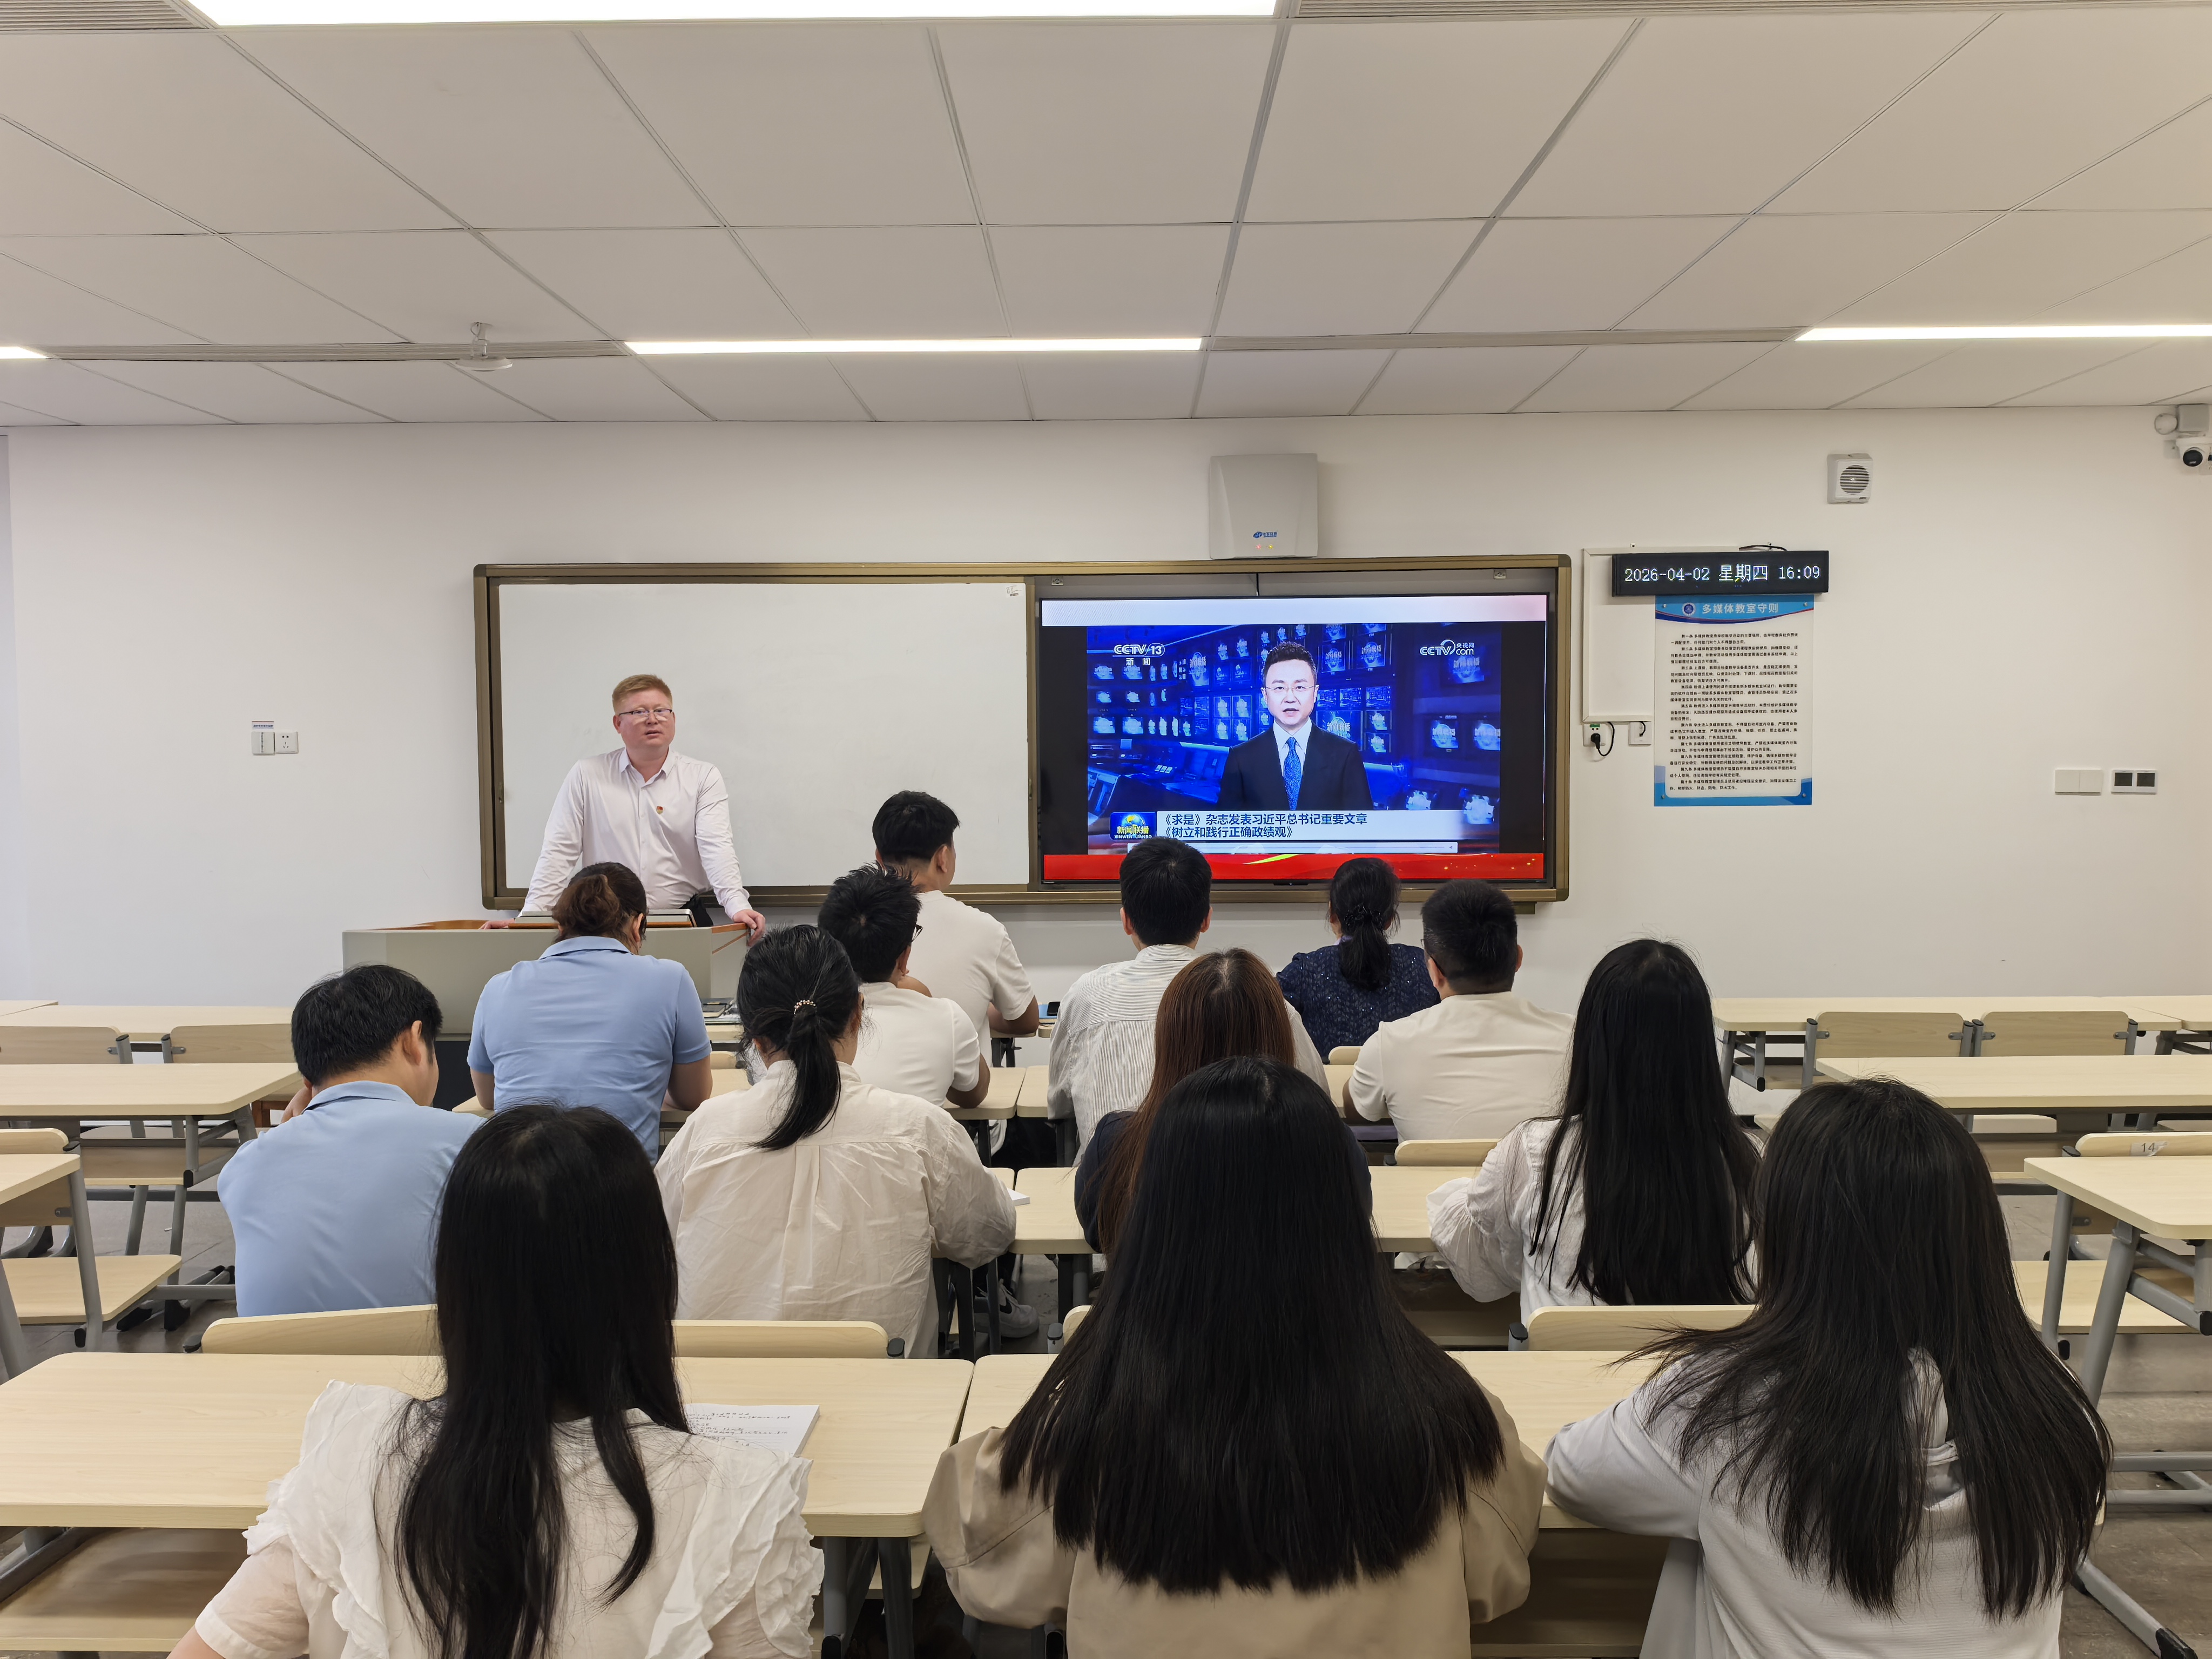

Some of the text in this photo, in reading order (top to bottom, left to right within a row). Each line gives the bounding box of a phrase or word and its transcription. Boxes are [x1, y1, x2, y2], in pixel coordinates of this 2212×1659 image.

[1624, 563, 1820, 582] 2026-04-02 星期四 16:09
[1702, 602, 1778, 614] 多媒体教室守则
[1114, 644, 1162, 655] CCTV 13
[1419, 646, 1452, 656] CCTV
[1165, 813, 1367, 826] 《求是》杂志发表习近平总书记重要文章
[1117, 825, 1149, 834] 新闻联播
[1165, 826, 1293, 839] 《树立和践行正确政绩观》
[2141, 1142, 2156, 1152] 14
